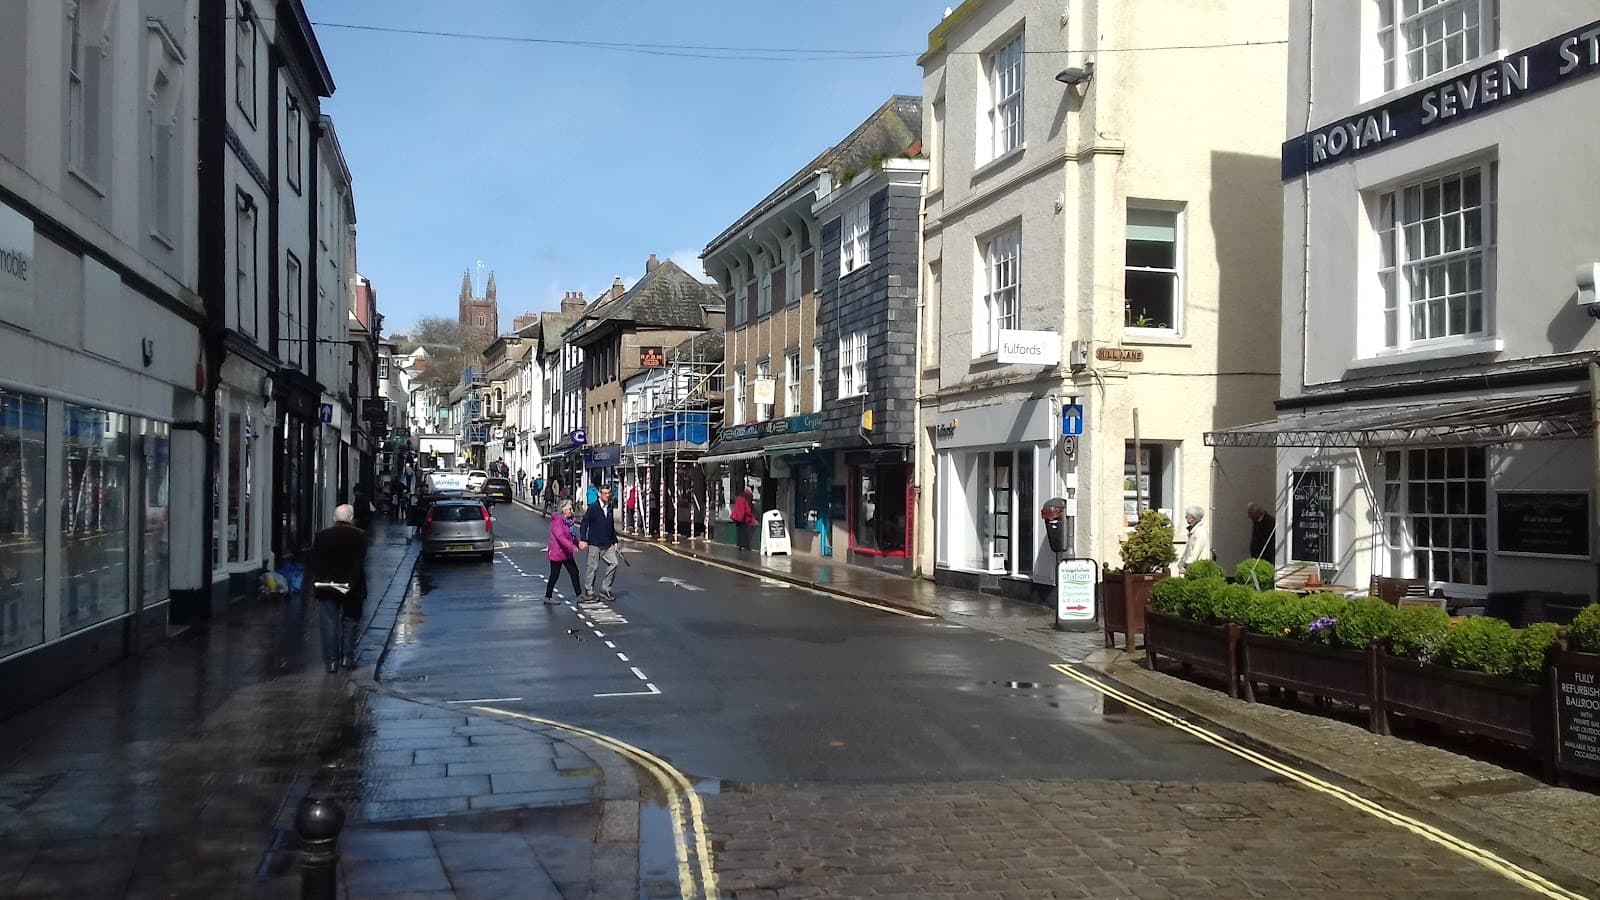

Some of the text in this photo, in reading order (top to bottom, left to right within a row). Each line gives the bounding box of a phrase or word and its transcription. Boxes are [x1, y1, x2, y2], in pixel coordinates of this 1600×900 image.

[1312, 109, 1397, 163] ROYAL
[1420, 55, 1529, 126] SEVEN
[1003, 342, 1042, 356] fulfords
[1575, 672, 1594, 684] FULLY
[1562, 682, 1600, 697] REFURBISH
[1566, 695, 1600, 710] BALLROO
